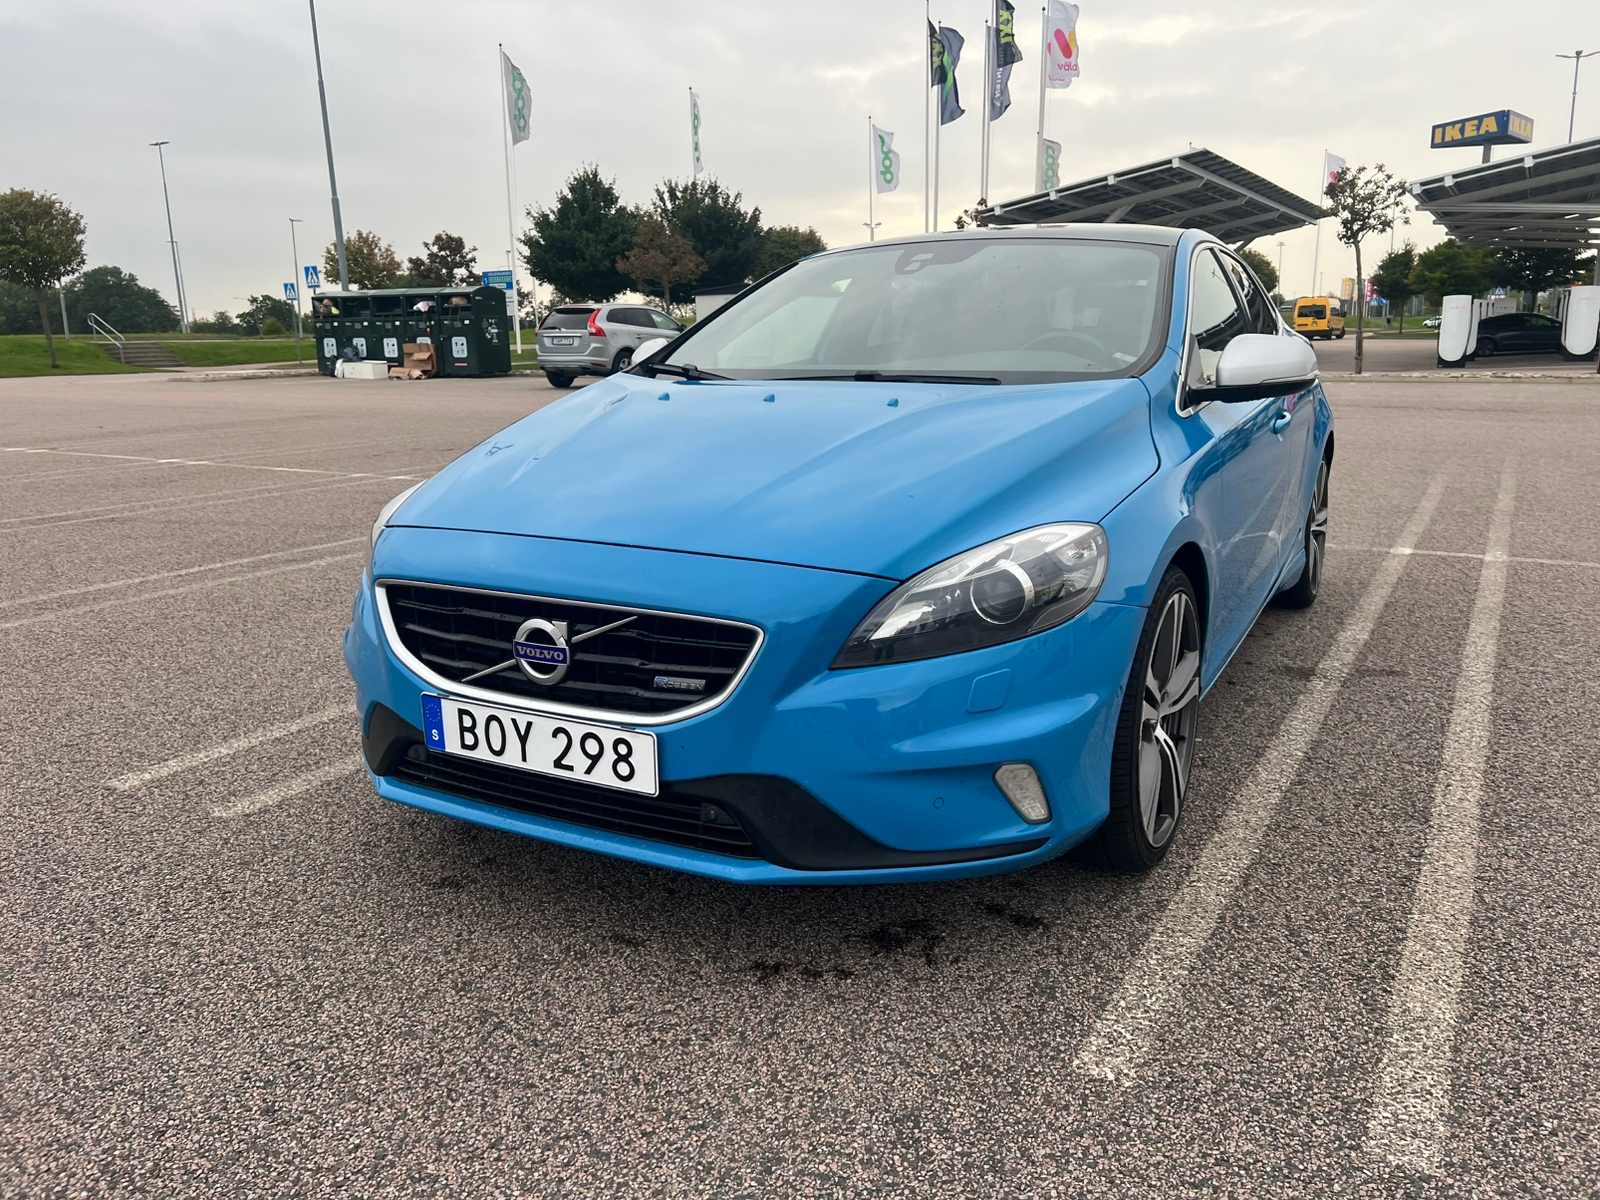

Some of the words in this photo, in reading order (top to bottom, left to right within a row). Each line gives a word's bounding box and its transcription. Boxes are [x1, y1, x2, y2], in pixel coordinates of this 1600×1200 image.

[1434, 116, 1498, 144] IKEA
[1509, 114, 1532, 140] IKEA
[516, 645, 564, 660] VOLVO
[431, 729, 439, 741] S
[457, 708, 533, 763] BOY
[551, 726, 636, 782] 298
